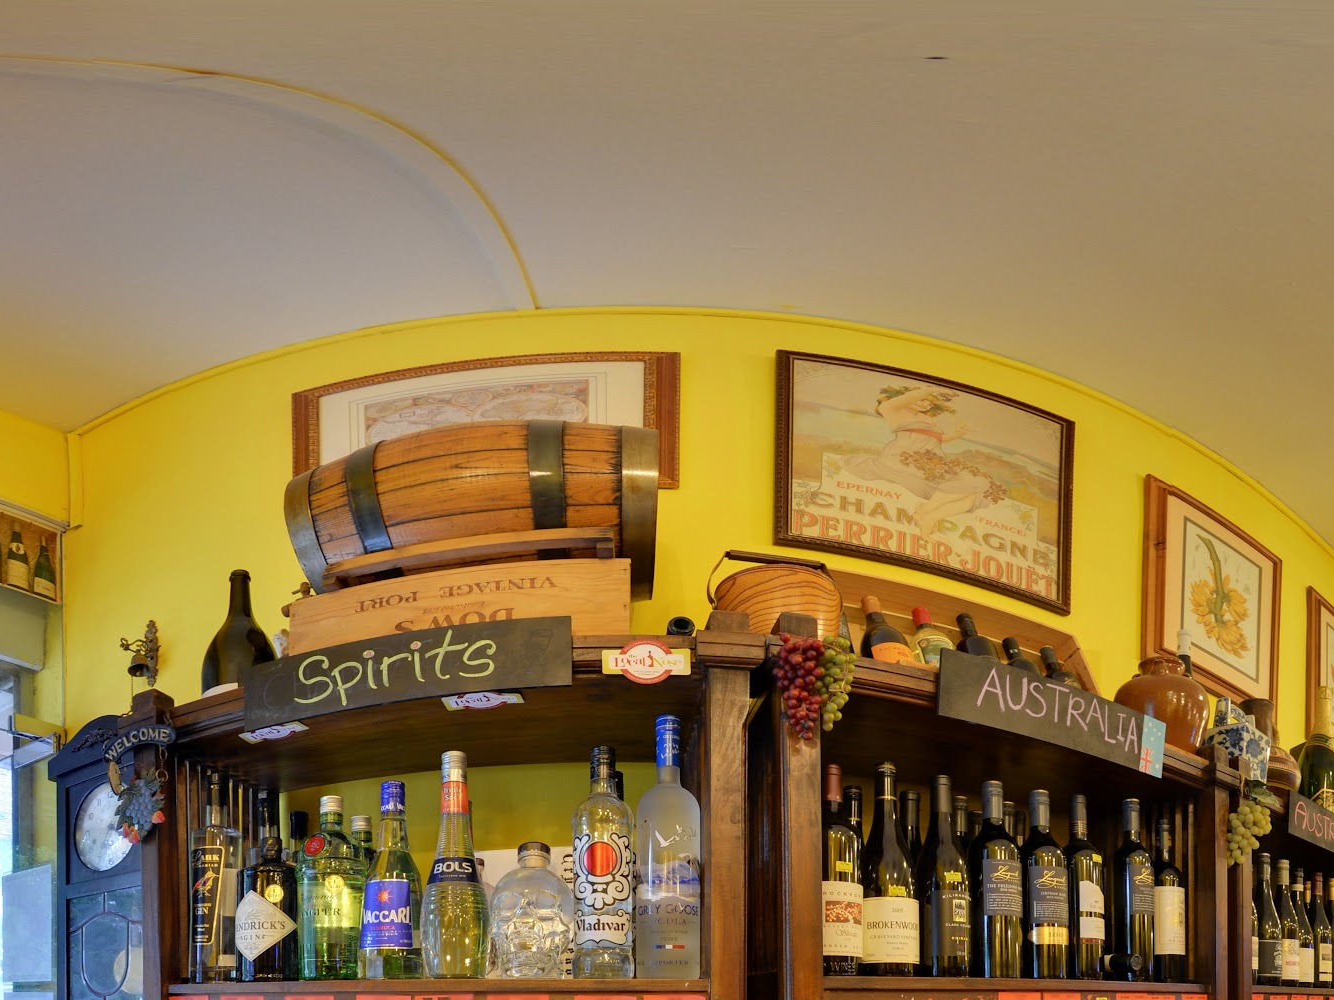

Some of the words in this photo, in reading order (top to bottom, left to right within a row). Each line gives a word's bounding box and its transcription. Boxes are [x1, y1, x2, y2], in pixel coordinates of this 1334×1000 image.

[835, 480, 903, 500] EPERNAY
[811, 489, 1055, 567] CHAMPAGNE
[439, 576, 557, 598] VINTAGE
[355, 591, 418, 613] PORT
[295, 629, 496, 706] Spirits
[976, 667, 1139, 755] AUSTRALIA
[433, 861, 473, 875] BOLS
[638, 905, 661, 917] GREY
[664, 904, 699, 917] GOOSE
[236, 920, 286, 933] ENDRICK'S
[575, 917, 626, 932] Vladivar
